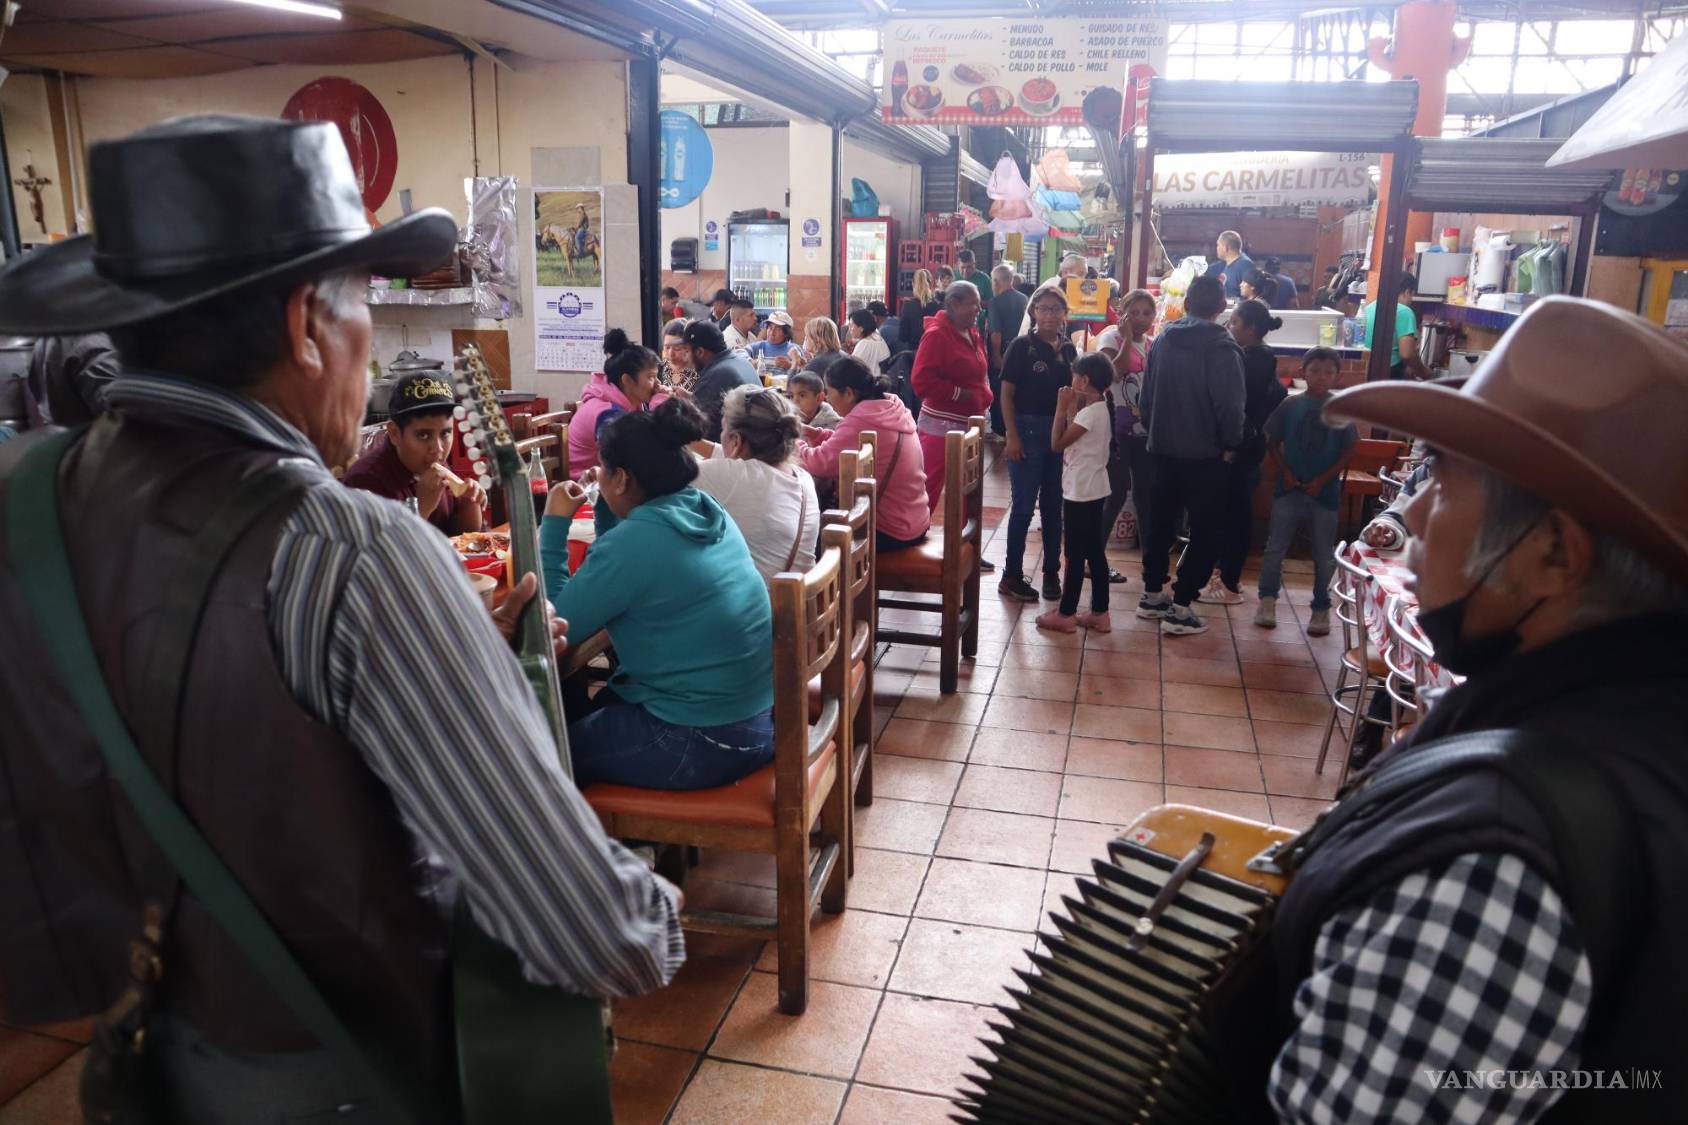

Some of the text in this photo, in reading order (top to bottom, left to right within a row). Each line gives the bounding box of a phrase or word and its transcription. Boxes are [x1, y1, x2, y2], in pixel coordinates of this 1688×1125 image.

[1010, 24, 1044, 33] MENUDO
[1088, 23, 1123, 33] GUISADO
[1126, 24, 1136, 32] DE
[1009, 37, 1054, 47] BARBACOA
[1087, 36, 1164, 46] ASADO DE PUERCO
[1009, 49, 1066, 59] CALDO DE RES
[1087, 49, 1146, 59] CHILE RELLENO
[1008, 62, 1076, 72] CALDO DE POLLO
[1086, 62, 1108, 72] MOLE
[1153, 166, 1367, 192] LAS CARMELITAS
